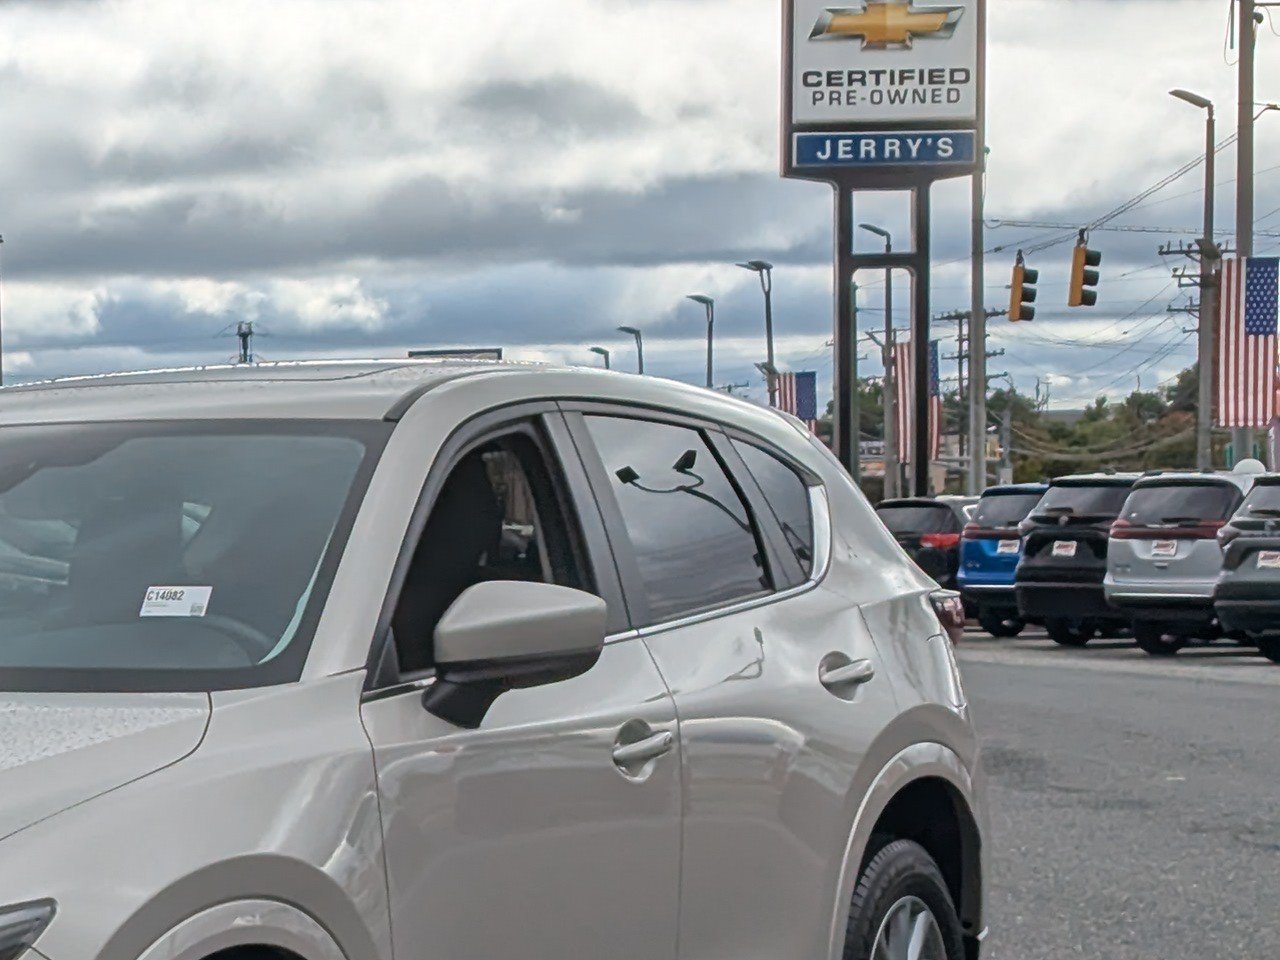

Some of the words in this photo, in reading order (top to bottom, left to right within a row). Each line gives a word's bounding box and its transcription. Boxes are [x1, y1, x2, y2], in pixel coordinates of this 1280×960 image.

[802, 67, 971, 88] CERTIFIED
[811, 88, 962, 107] PRE-OWNED
[816, 137, 955, 161] JERRY'S
